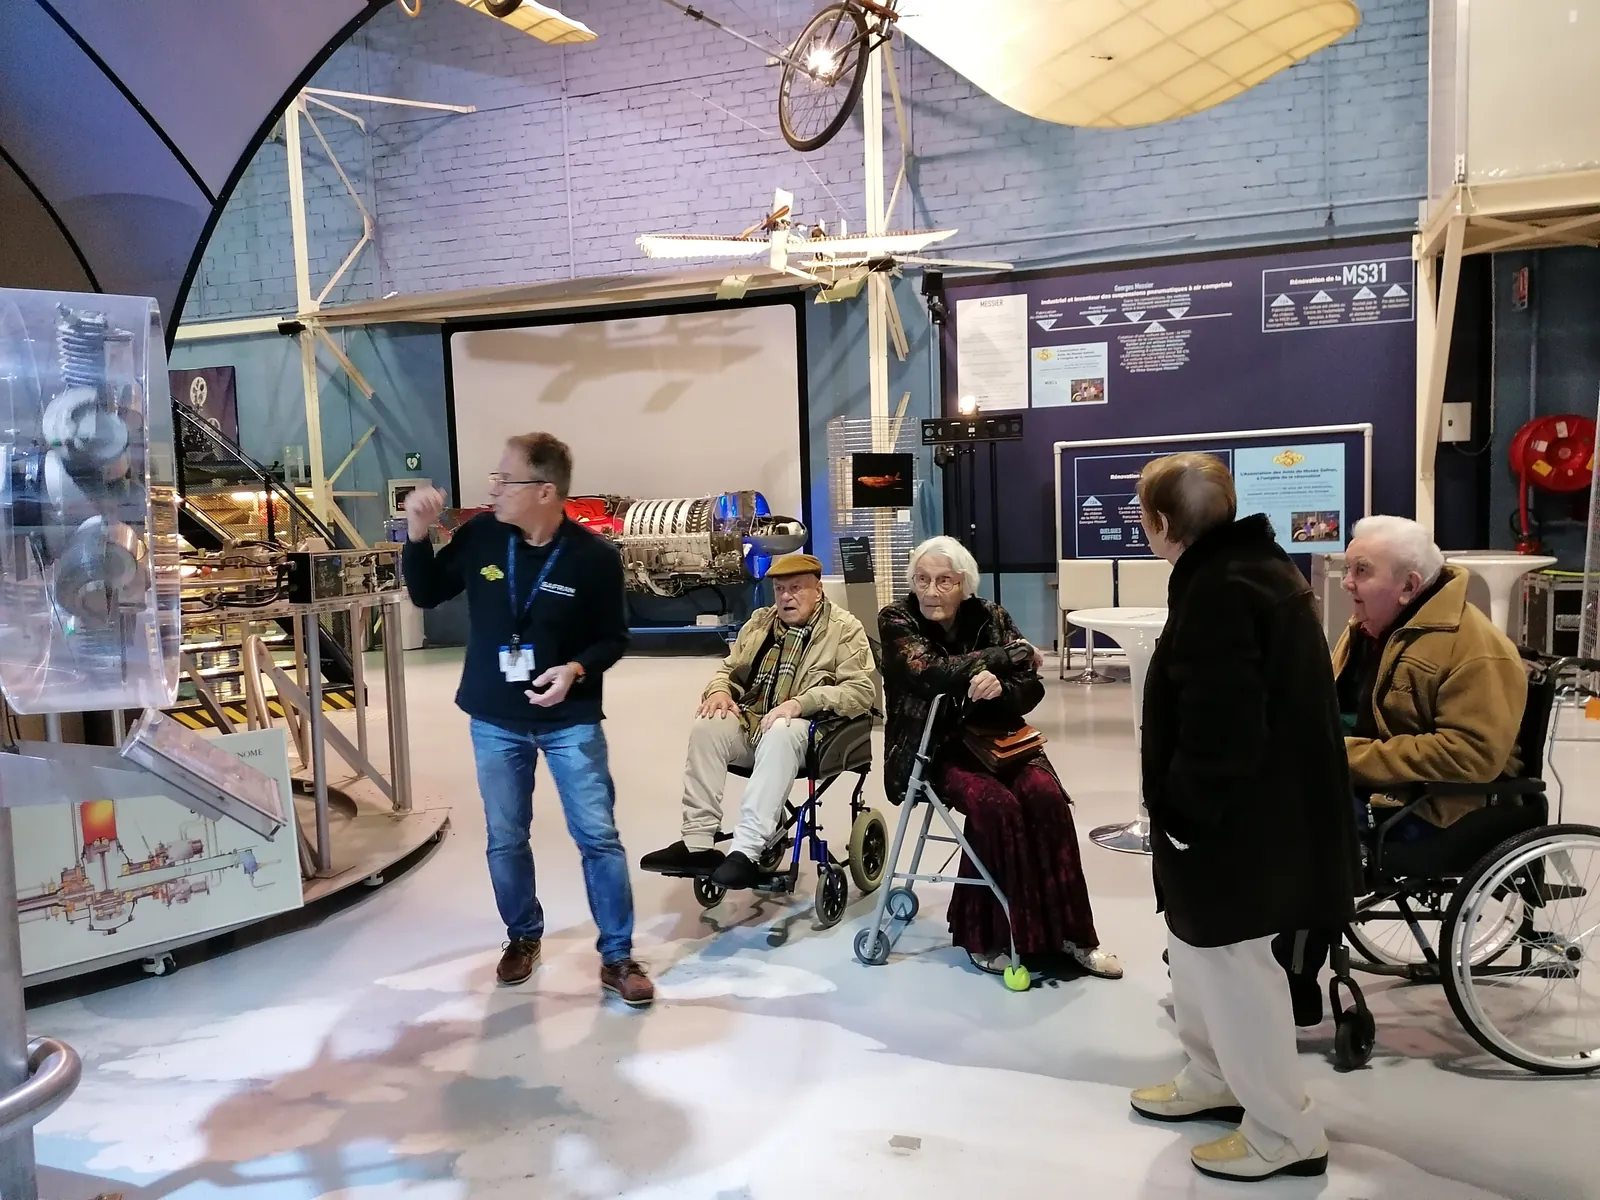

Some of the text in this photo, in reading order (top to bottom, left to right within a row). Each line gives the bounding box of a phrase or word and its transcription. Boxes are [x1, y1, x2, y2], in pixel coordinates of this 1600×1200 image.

[1289, 277, 1325, 286] Rénovation
[1342, 262, 1387, 286] MS31
[1114, 282, 1154, 292] Georges Messier
[1041, 297, 1067, 305] Industriel
[1147, 286, 1188, 296] pneumatiques
[1202, 281, 1232, 290] comprimé
[980, 299, 1004, 308] MESSIER
[237, 748, 264, 758] NOME
